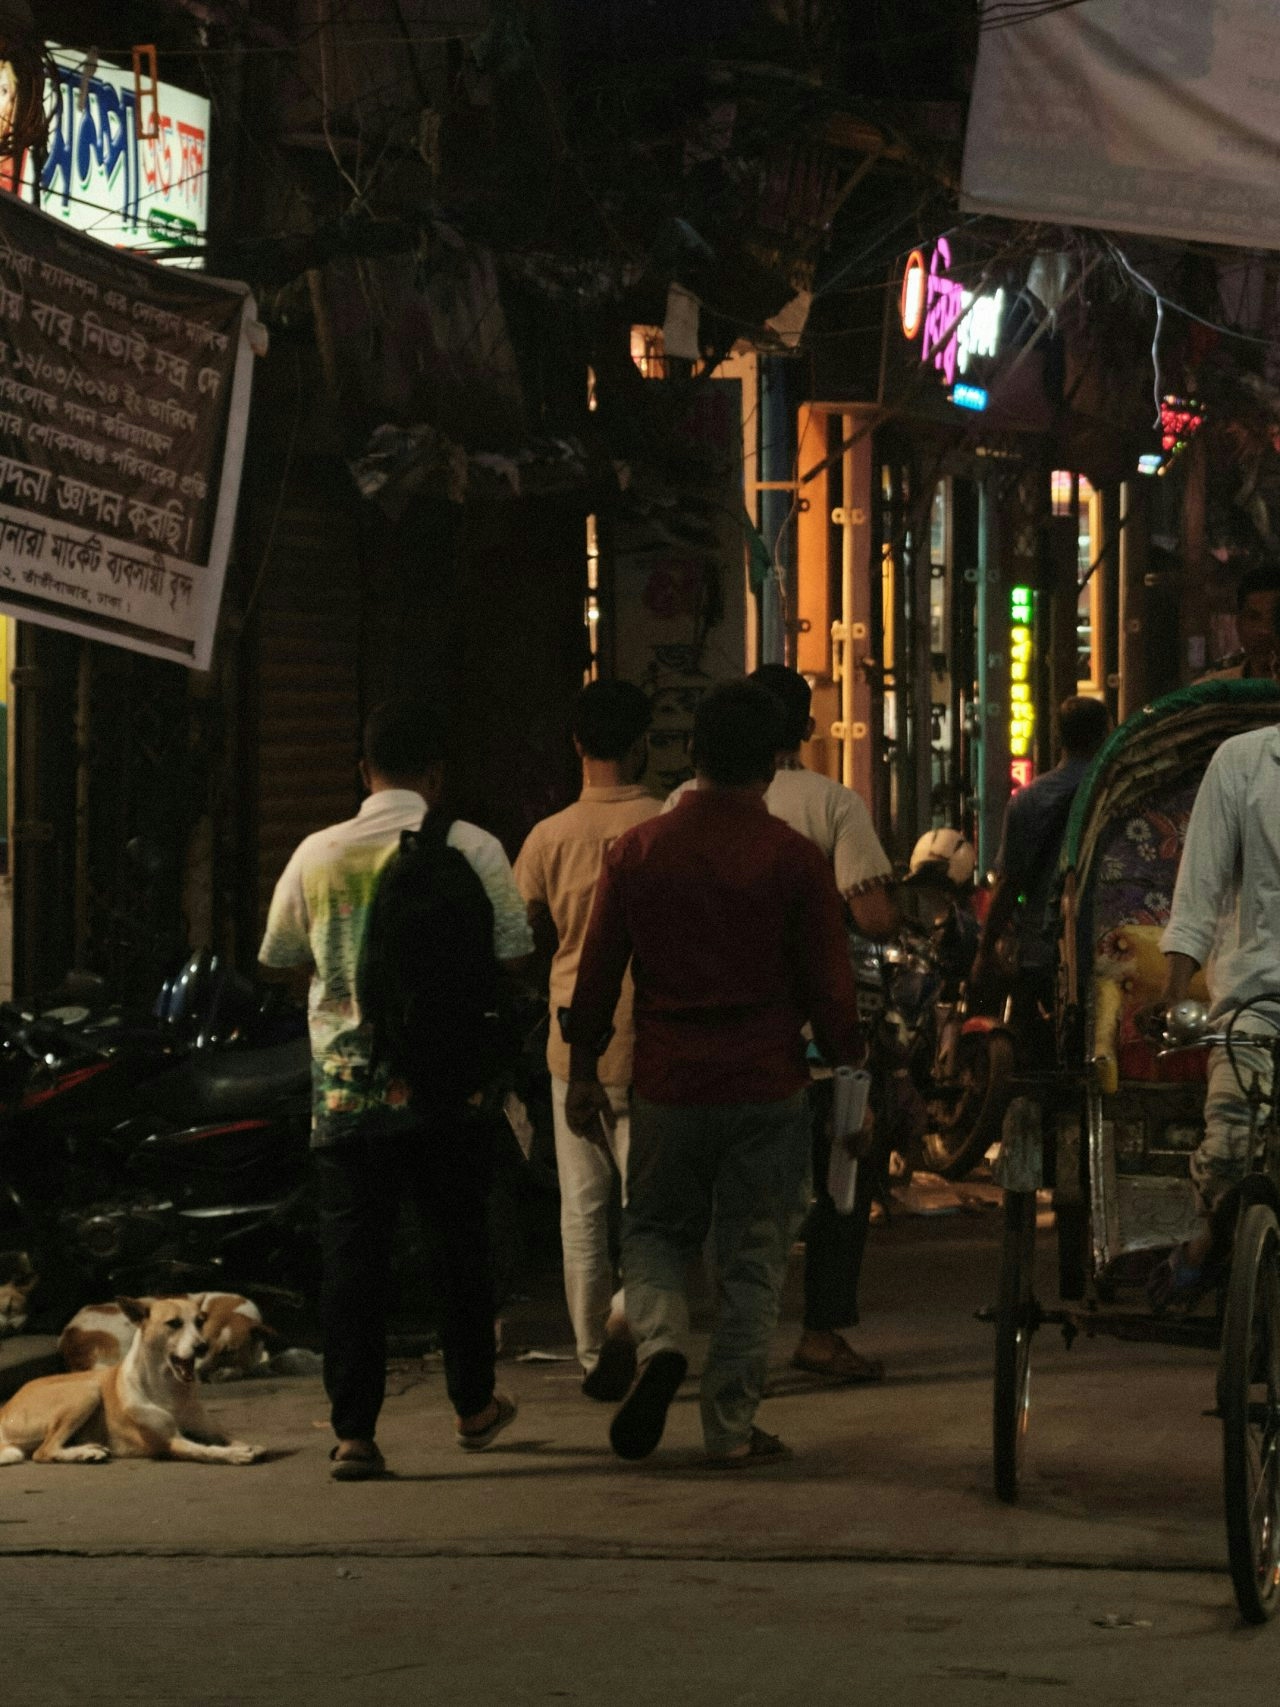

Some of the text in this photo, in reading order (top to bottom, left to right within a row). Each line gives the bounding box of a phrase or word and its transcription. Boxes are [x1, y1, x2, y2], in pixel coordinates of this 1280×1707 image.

[31, 299, 75, 352] বাবু
[81, 309, 149, 375] নিতাই
[153, 347, 191, 398] চন্দ্র
[198, 366, 222, 400] দে
[57, 474, 124, 528] জ্ঞাপন
[52, 531, 102, 573] মার্কেট
[170, 569, 193, 613] বৃন্দ
